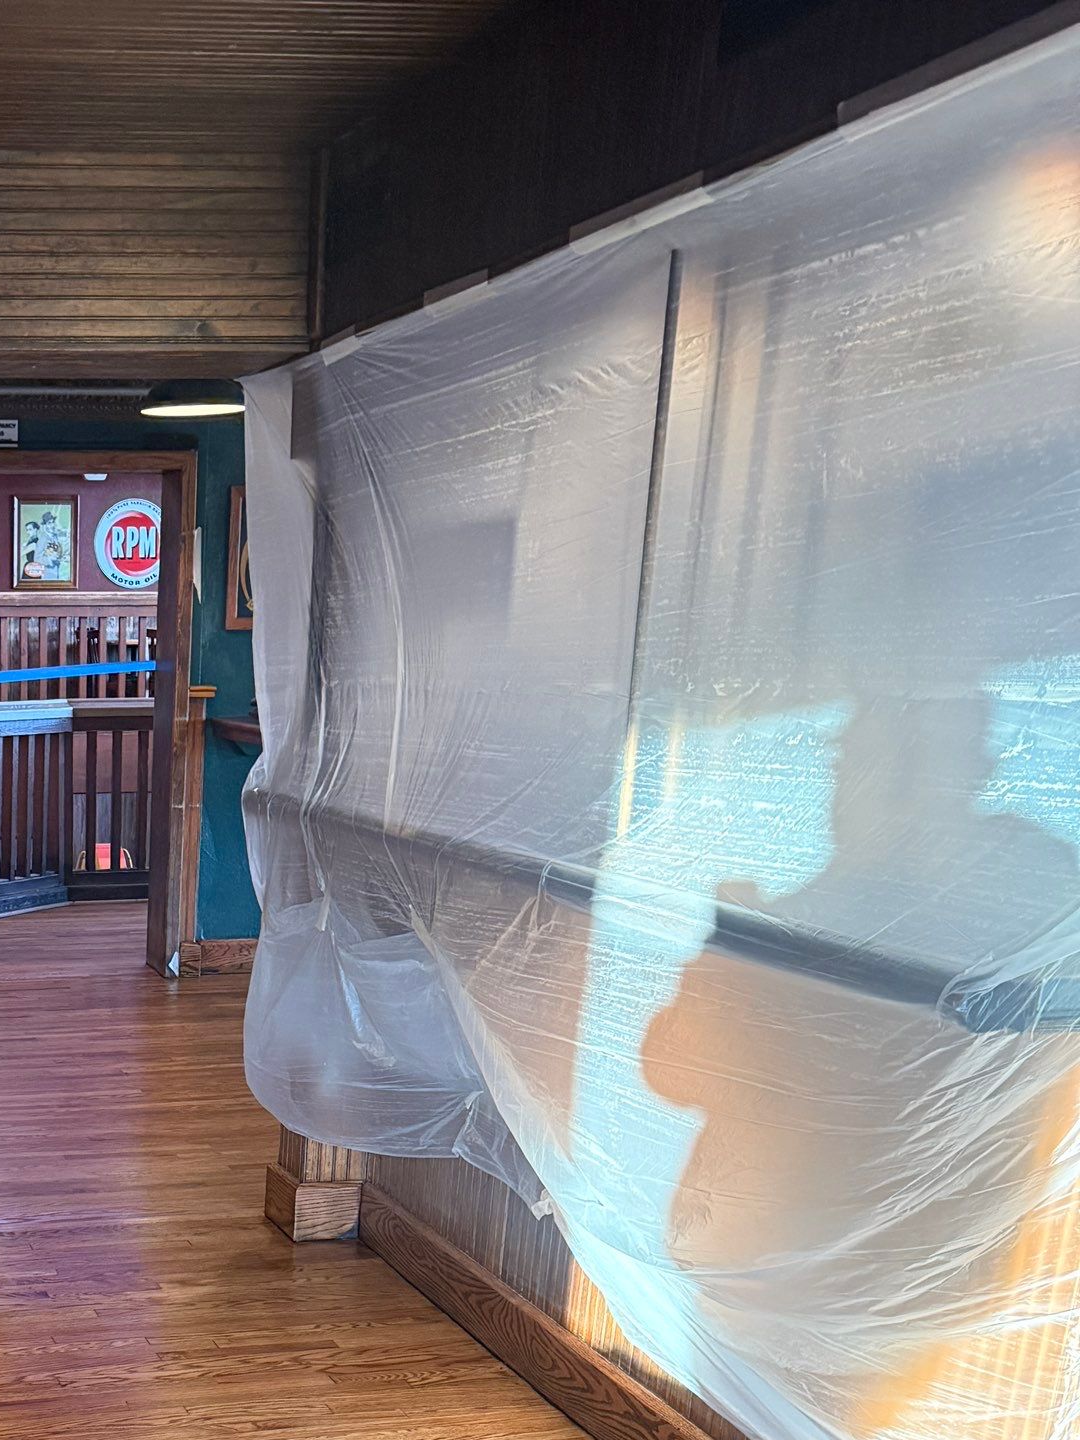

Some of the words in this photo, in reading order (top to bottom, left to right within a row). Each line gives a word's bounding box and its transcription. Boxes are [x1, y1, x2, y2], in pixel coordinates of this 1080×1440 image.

[112, 526, 158, 560] RPM
[110, 572, 141, 586] MOTOR
[144, 573, 158, 584] OIL
